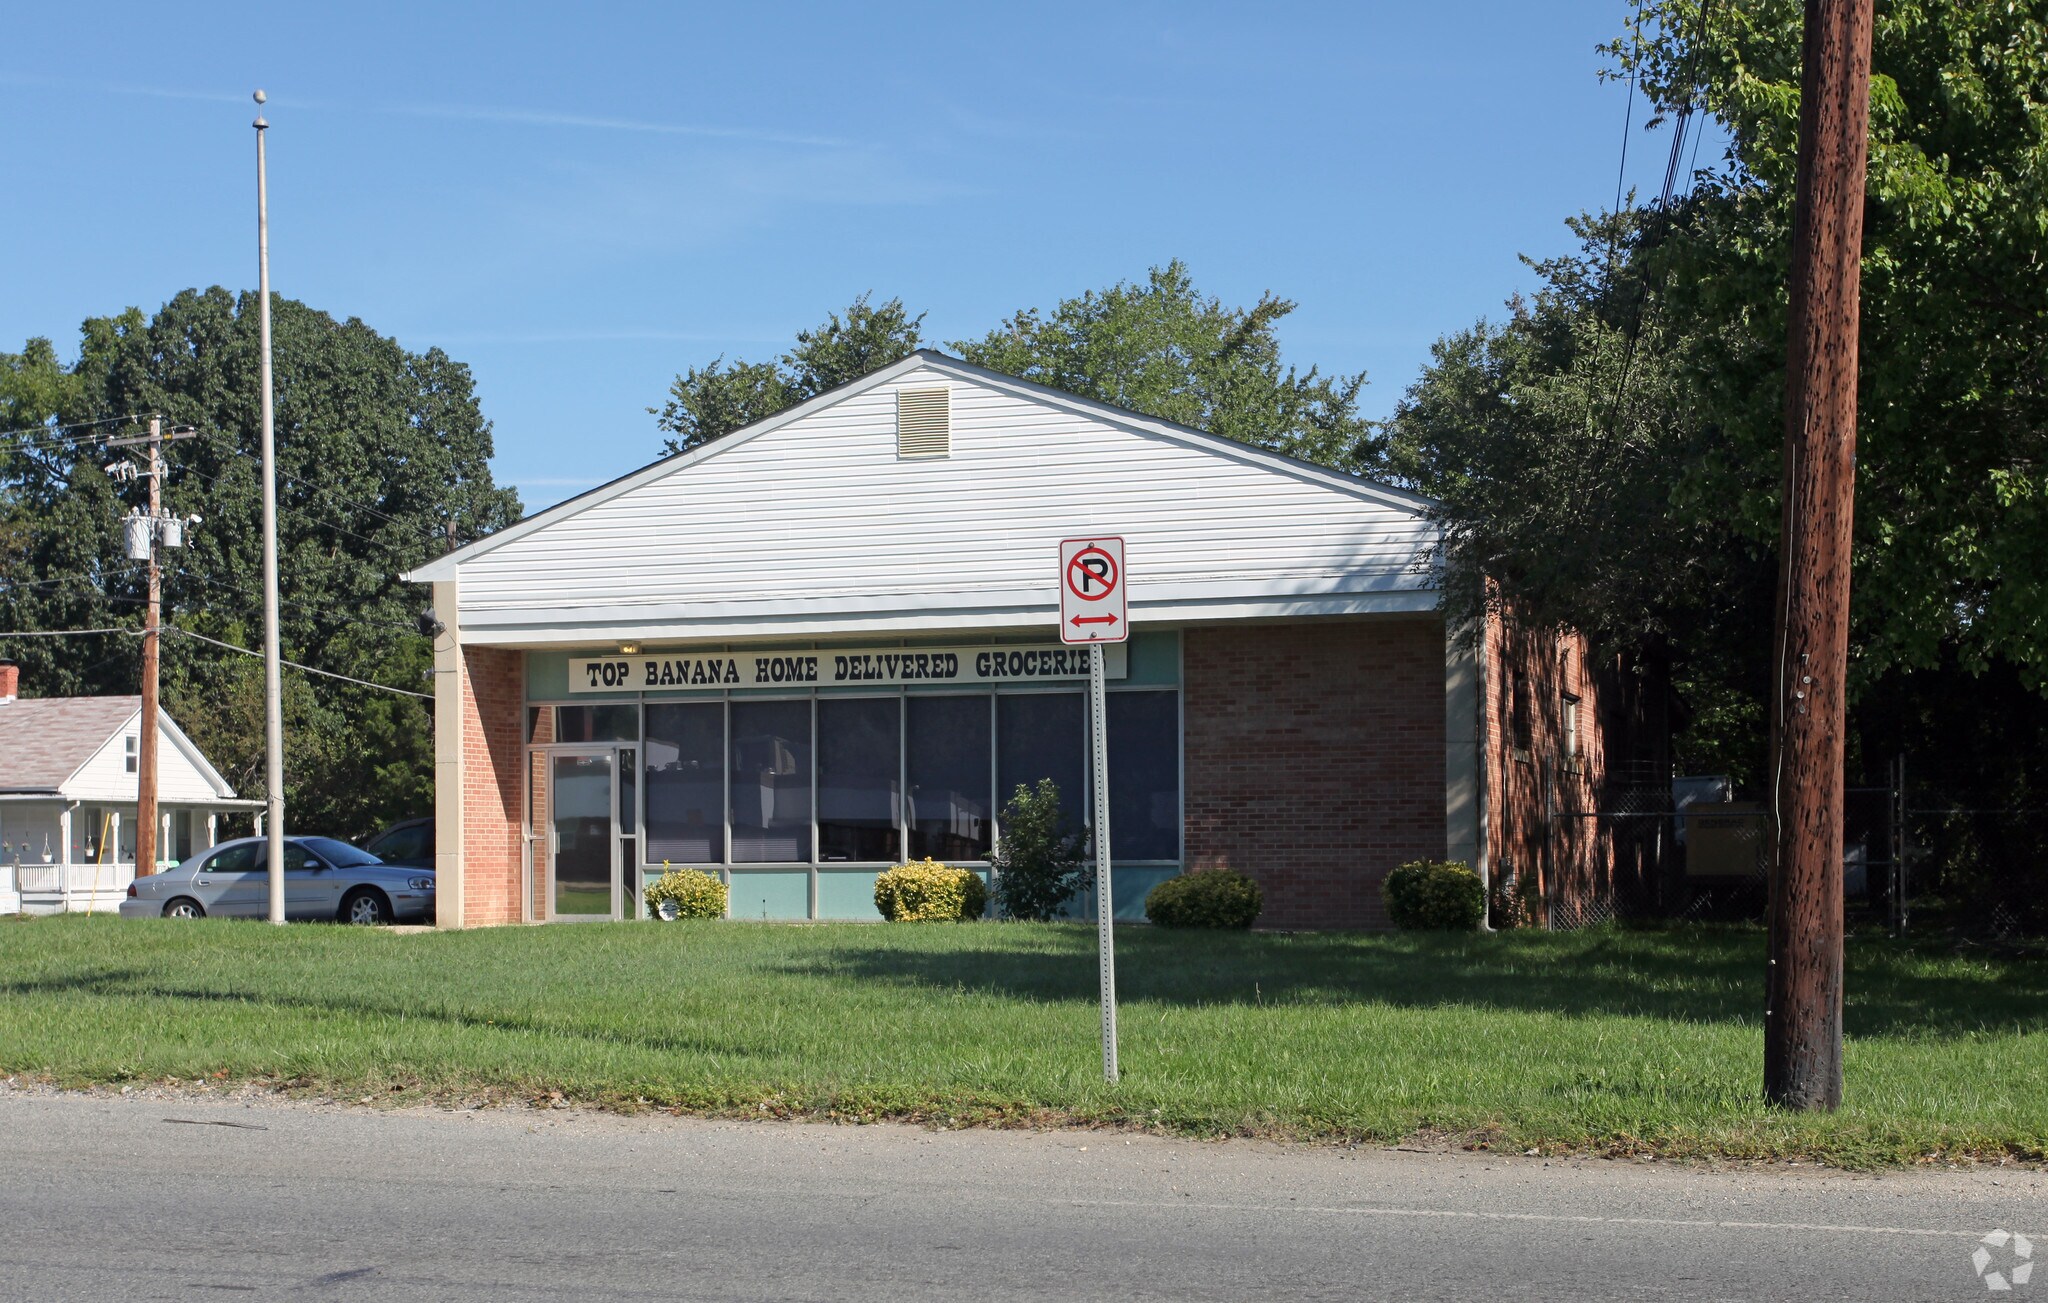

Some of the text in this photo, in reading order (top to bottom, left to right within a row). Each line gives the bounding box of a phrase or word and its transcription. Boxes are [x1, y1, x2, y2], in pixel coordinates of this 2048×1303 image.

[1082, 558, 1108, 592] P
[586, 649, 1106, 687] TOP BANANA HOME DELIVERED GROCERIE
